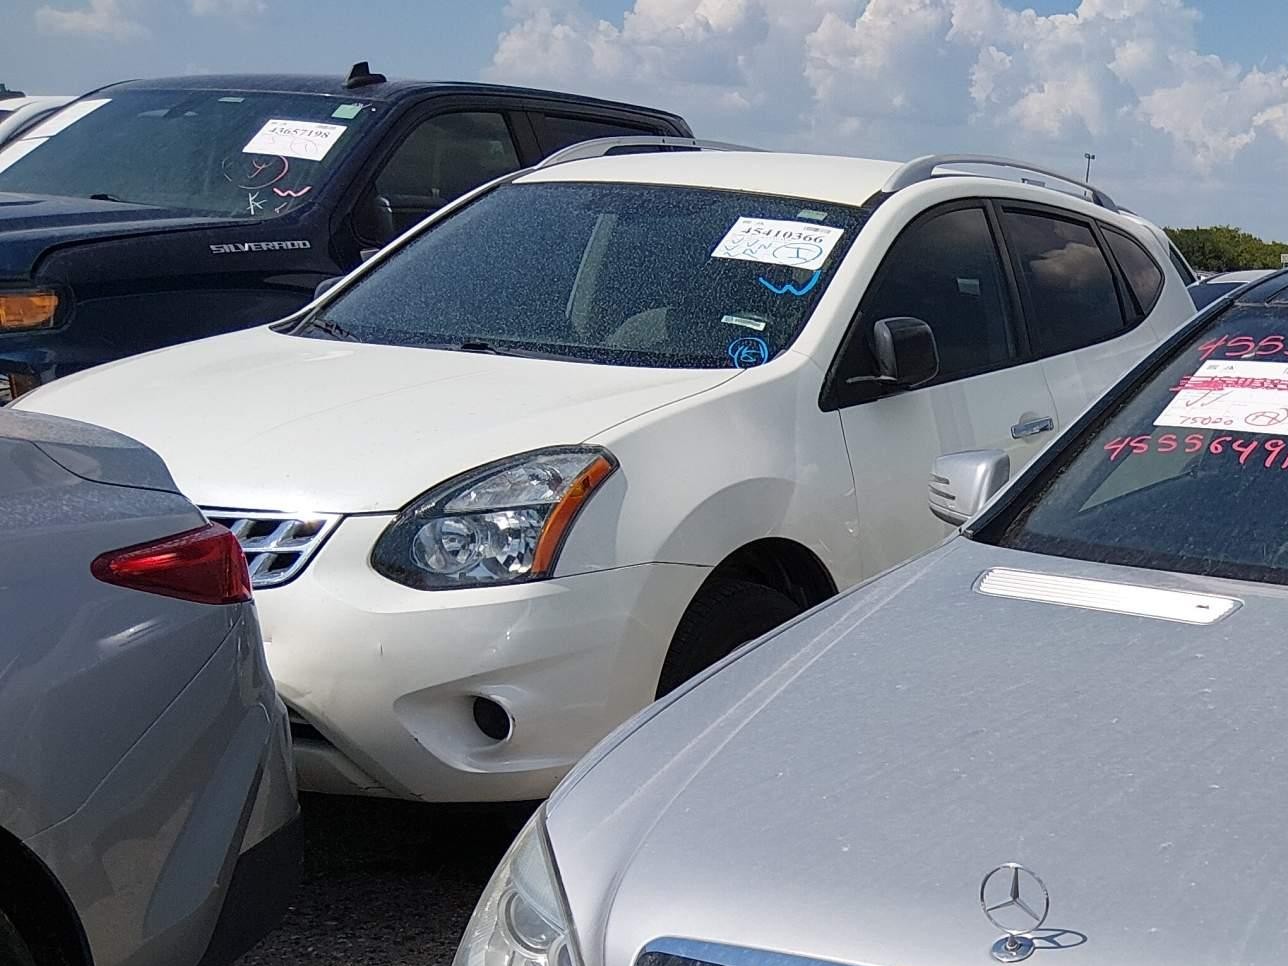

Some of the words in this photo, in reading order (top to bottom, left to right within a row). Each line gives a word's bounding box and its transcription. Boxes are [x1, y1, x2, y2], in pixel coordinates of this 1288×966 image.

[269, 127, 330, 139] 43657198
[742, 226, 825, 244] 45410366
[209, 240, 311, 254] SILVERADO
